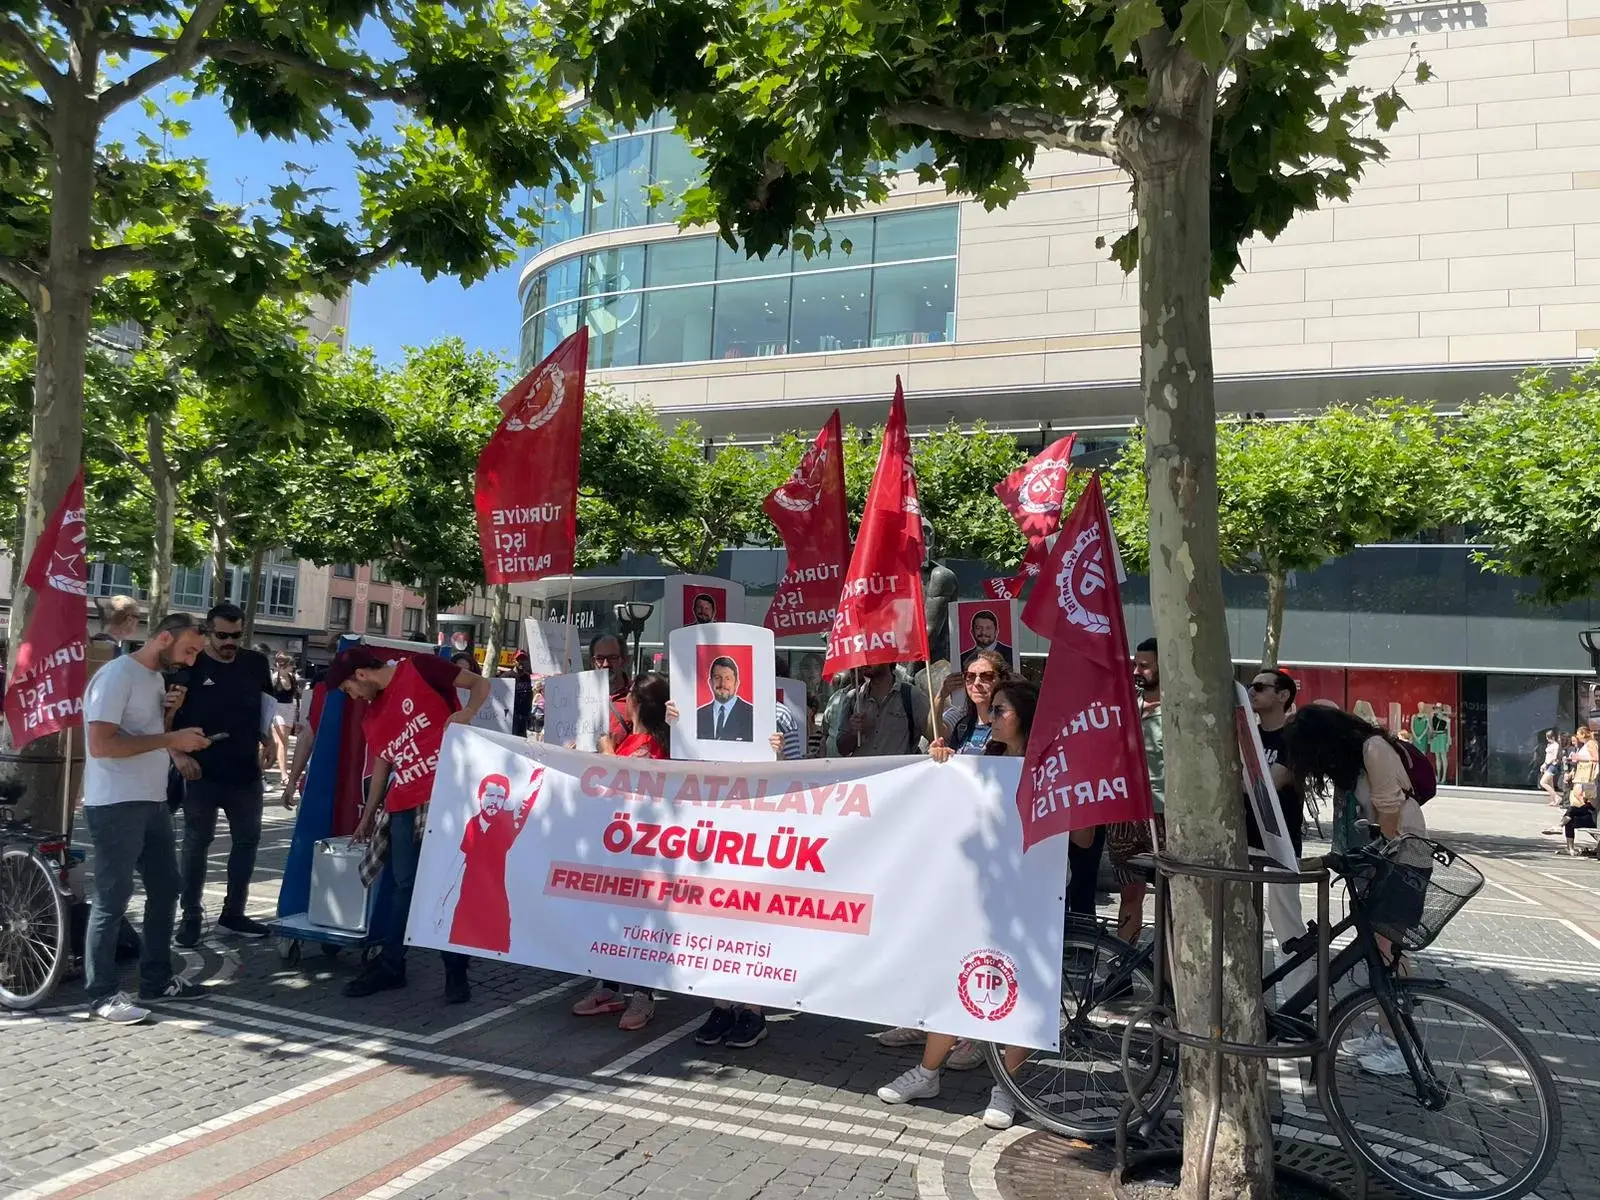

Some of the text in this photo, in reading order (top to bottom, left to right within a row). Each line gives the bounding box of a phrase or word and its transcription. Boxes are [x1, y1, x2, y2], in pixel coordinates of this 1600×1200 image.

[394, 738, 420, 768] ŞÇİ
[580, 766, 872, 818] CAN ATALAY'A
[603, 812, 829, 873] ÖZGÜRLÜK
[551, 869, 866, 924] FREIHEIT FÜR CAN ATALAY
[590, 941, 798, 983] ARBEITERPARTEI DER TÜRKEI
[623, 926, 771, 958] TÜRKİYE İŞÇİ PARTİSİ
